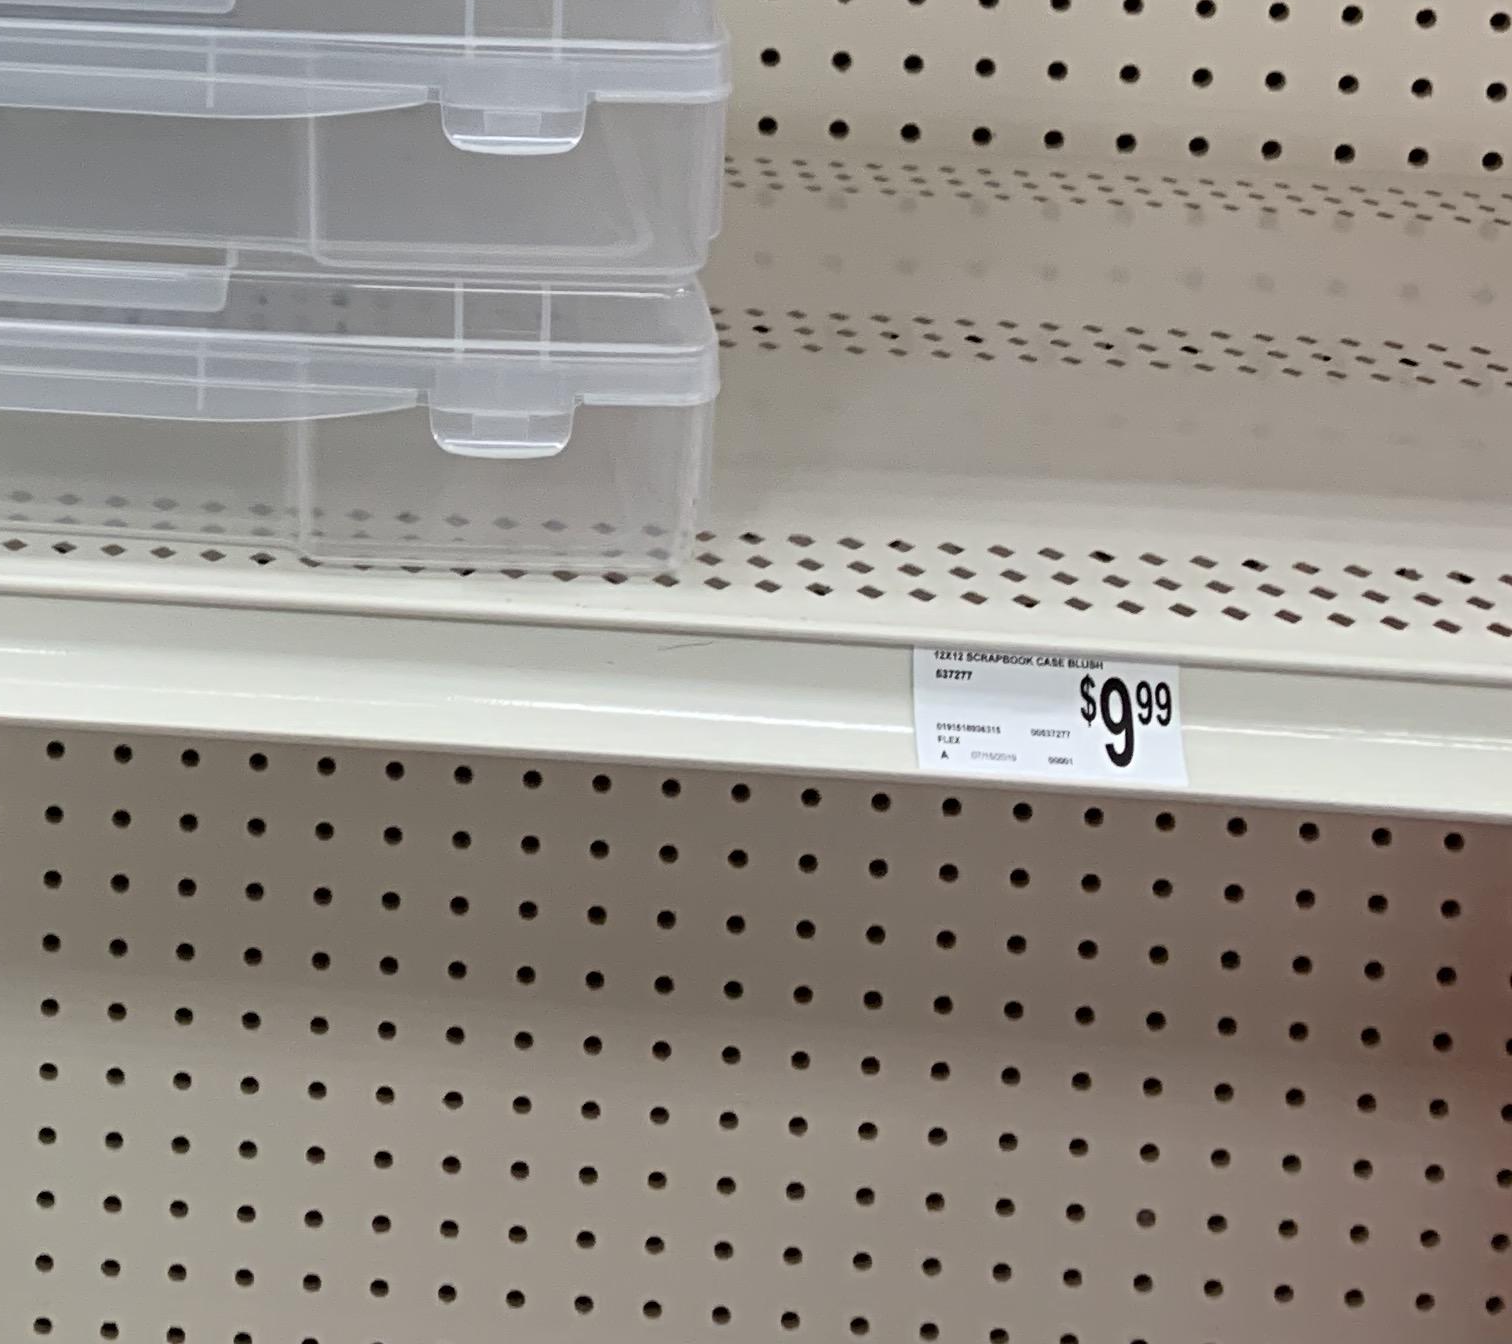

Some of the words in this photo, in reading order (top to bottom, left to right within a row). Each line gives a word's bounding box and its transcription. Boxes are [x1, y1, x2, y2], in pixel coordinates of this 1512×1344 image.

[966, 651, 1033, 666] SCRAPBOOK
[1036, 656, 1065, 667] CASE
[1068, 658, 1104, 670] BLUSH
[940, 749, 950, 760] A
